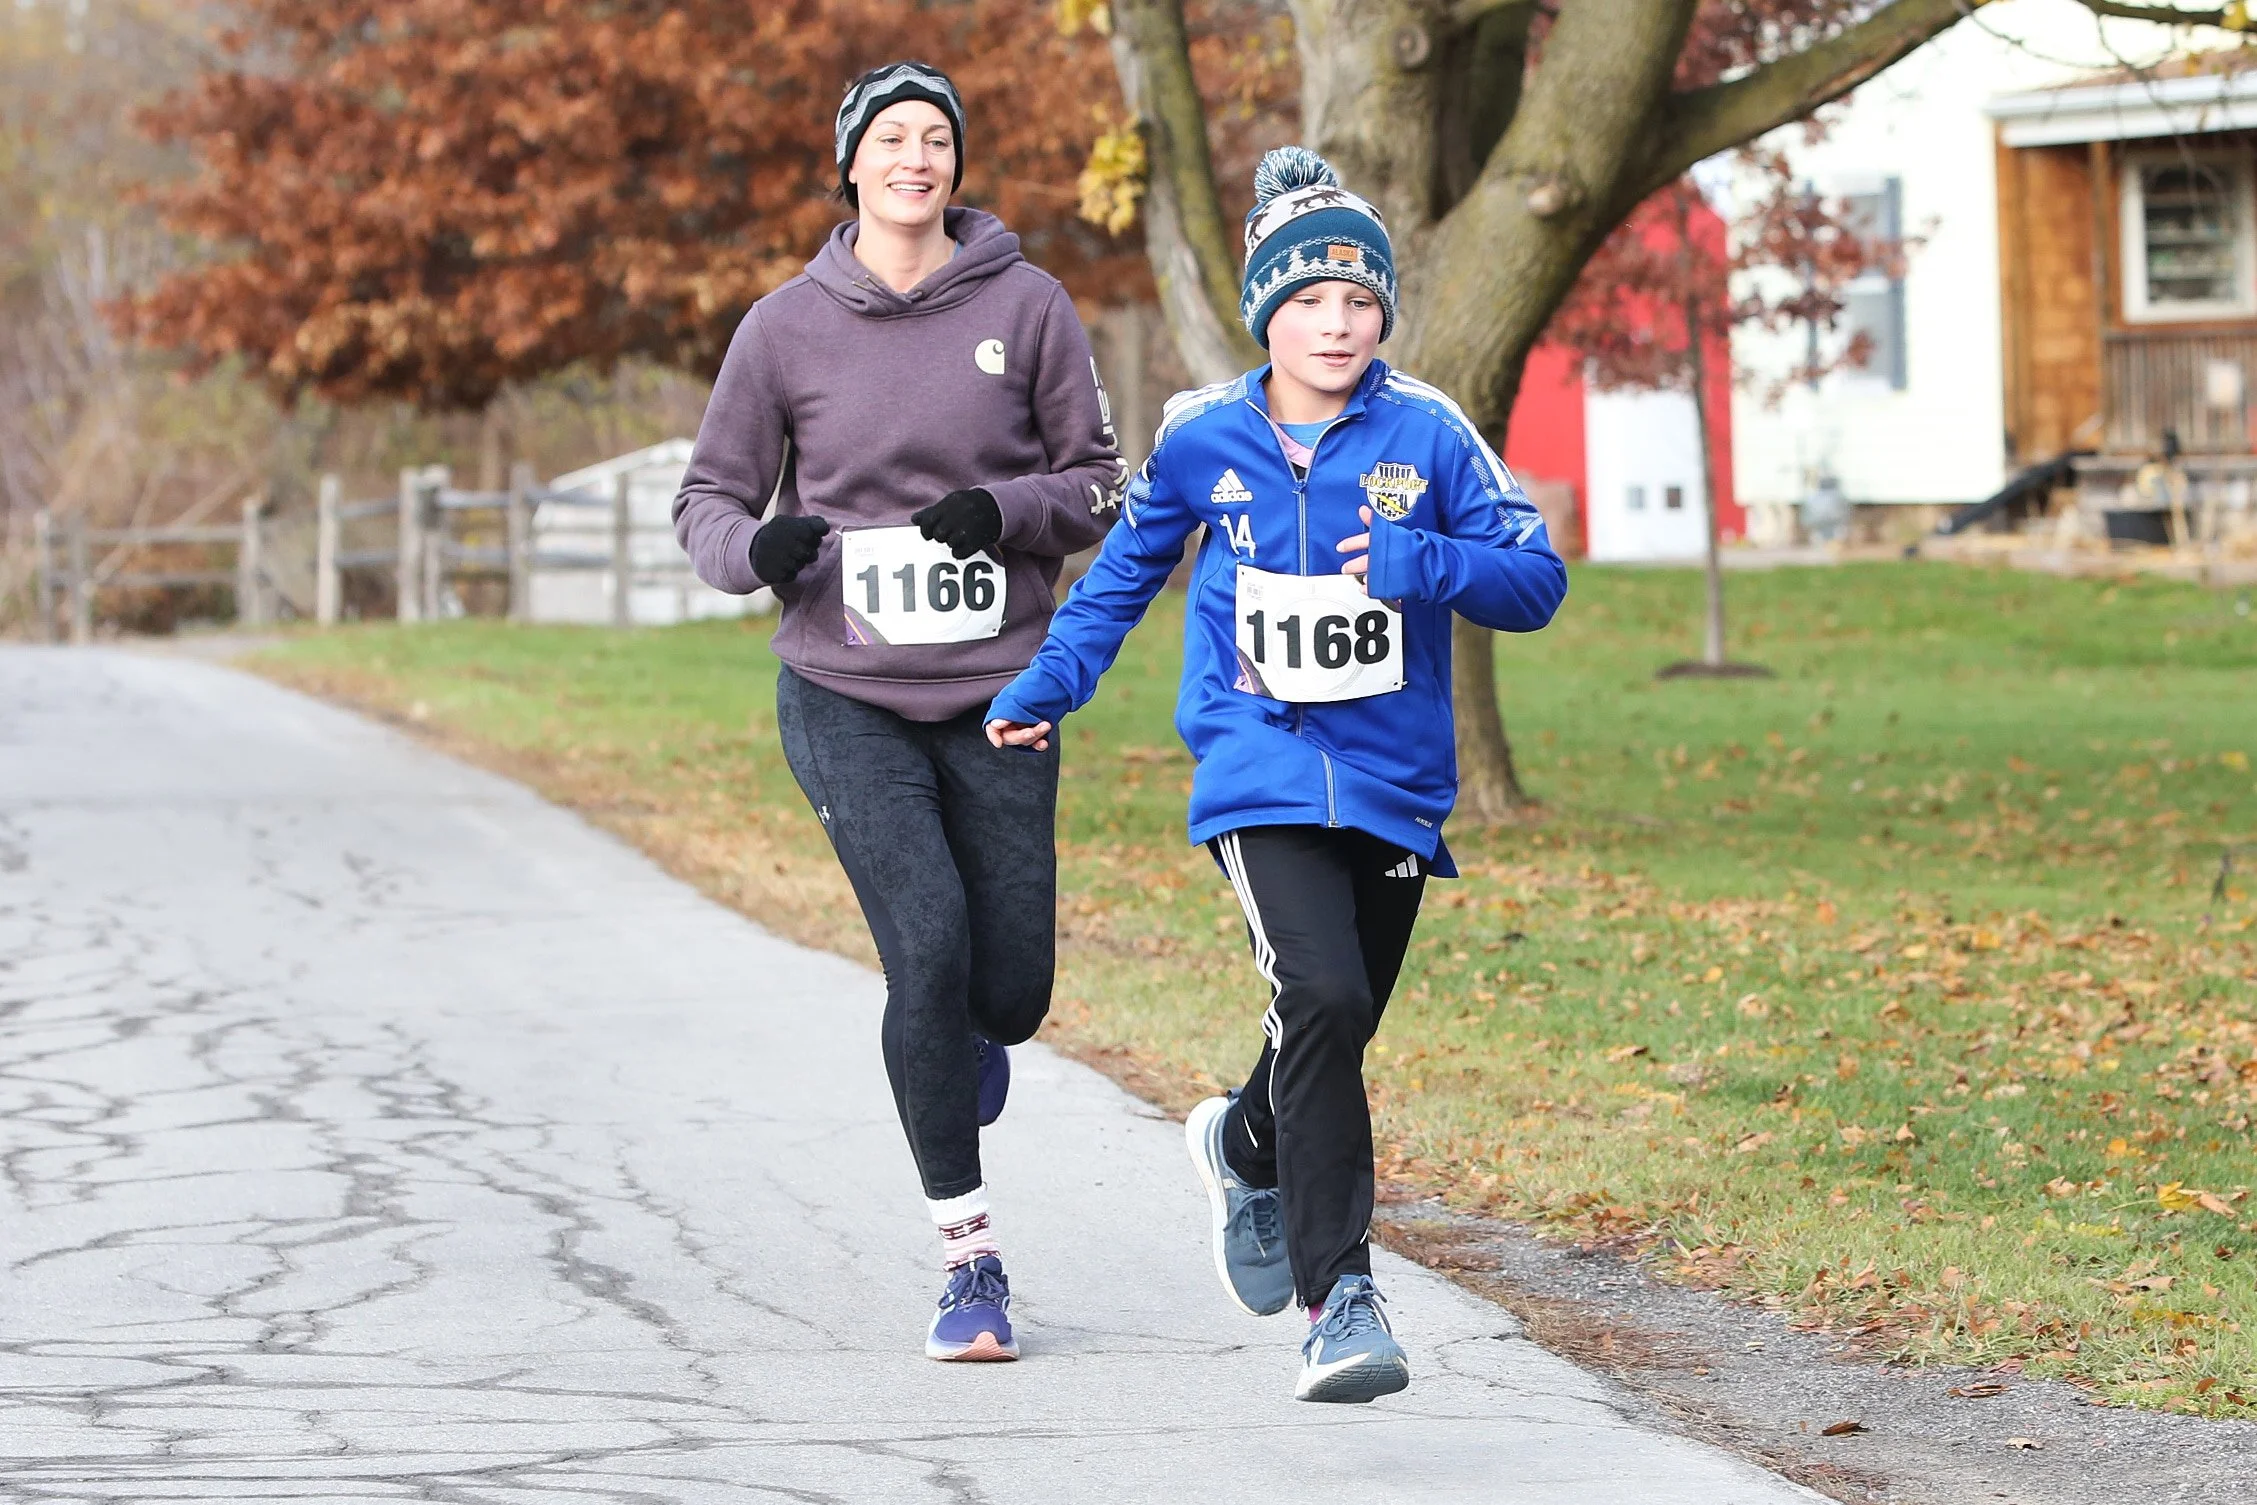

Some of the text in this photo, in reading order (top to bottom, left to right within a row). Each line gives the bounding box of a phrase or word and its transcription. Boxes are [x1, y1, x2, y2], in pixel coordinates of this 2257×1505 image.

[1210, 490, 1253, 504] adidas
[1361, 474, 1427, 492] LOCKPORT
[1219, 513, 1256, 558] 14
[857, 561, 996, 614] 1166
[1246, 610, 1390, 669] 1168
